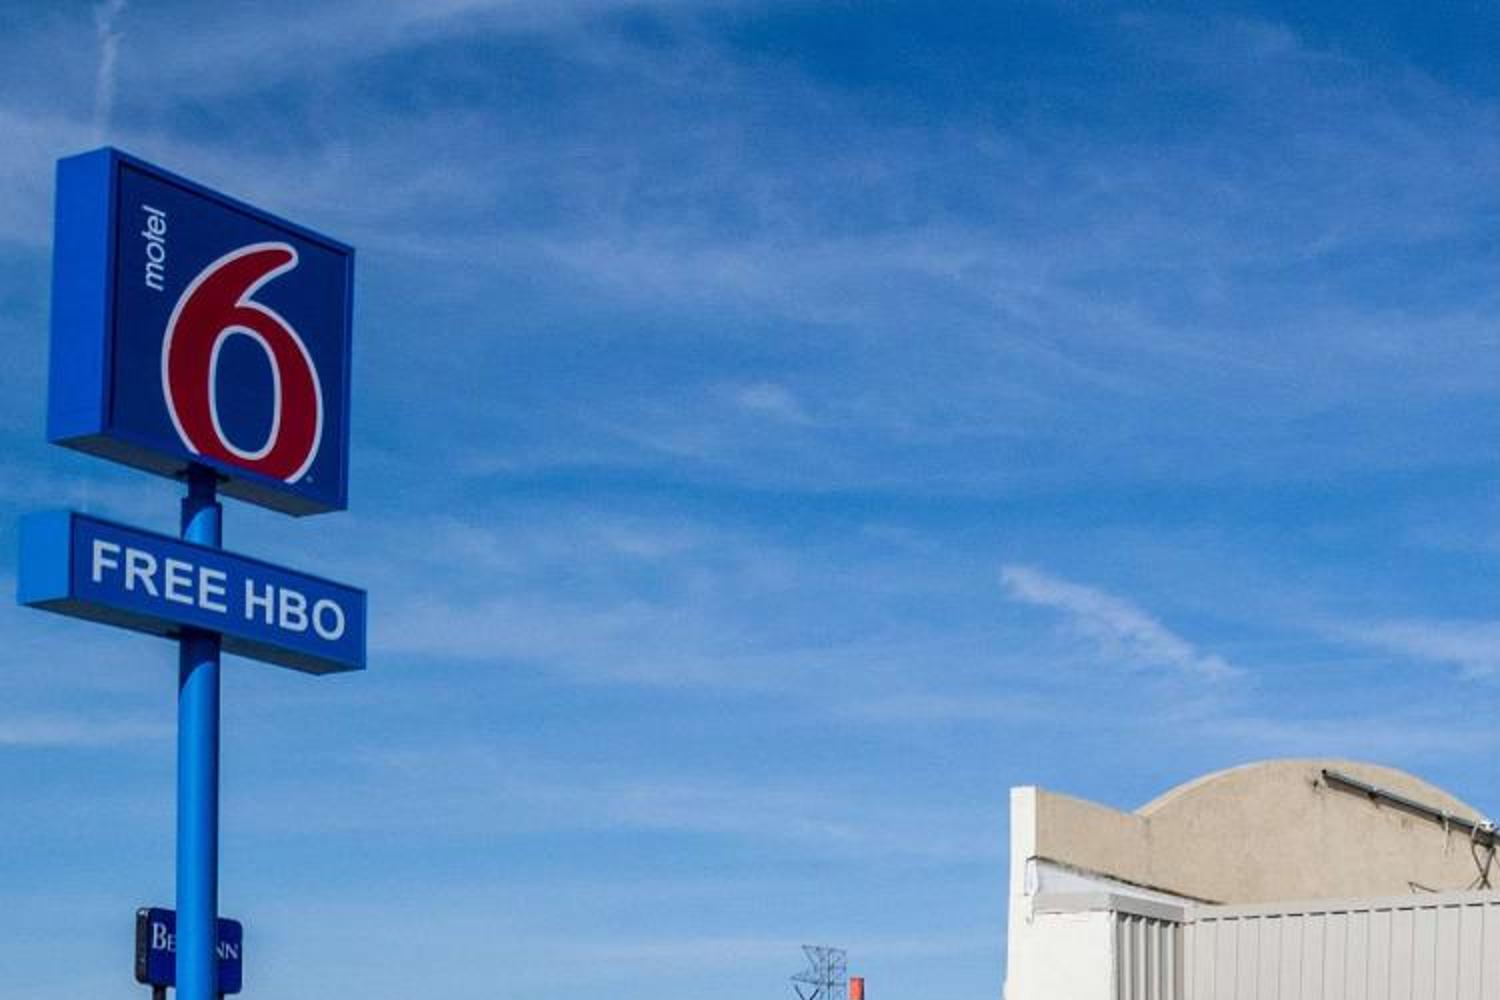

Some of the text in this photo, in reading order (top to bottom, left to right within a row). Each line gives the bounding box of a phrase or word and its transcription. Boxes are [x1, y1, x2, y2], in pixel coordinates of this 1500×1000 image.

[142, 205, 167, 292] motel
[162, 241, 323, 484] 6
[92, 538, 346, 641] FREE HBO
